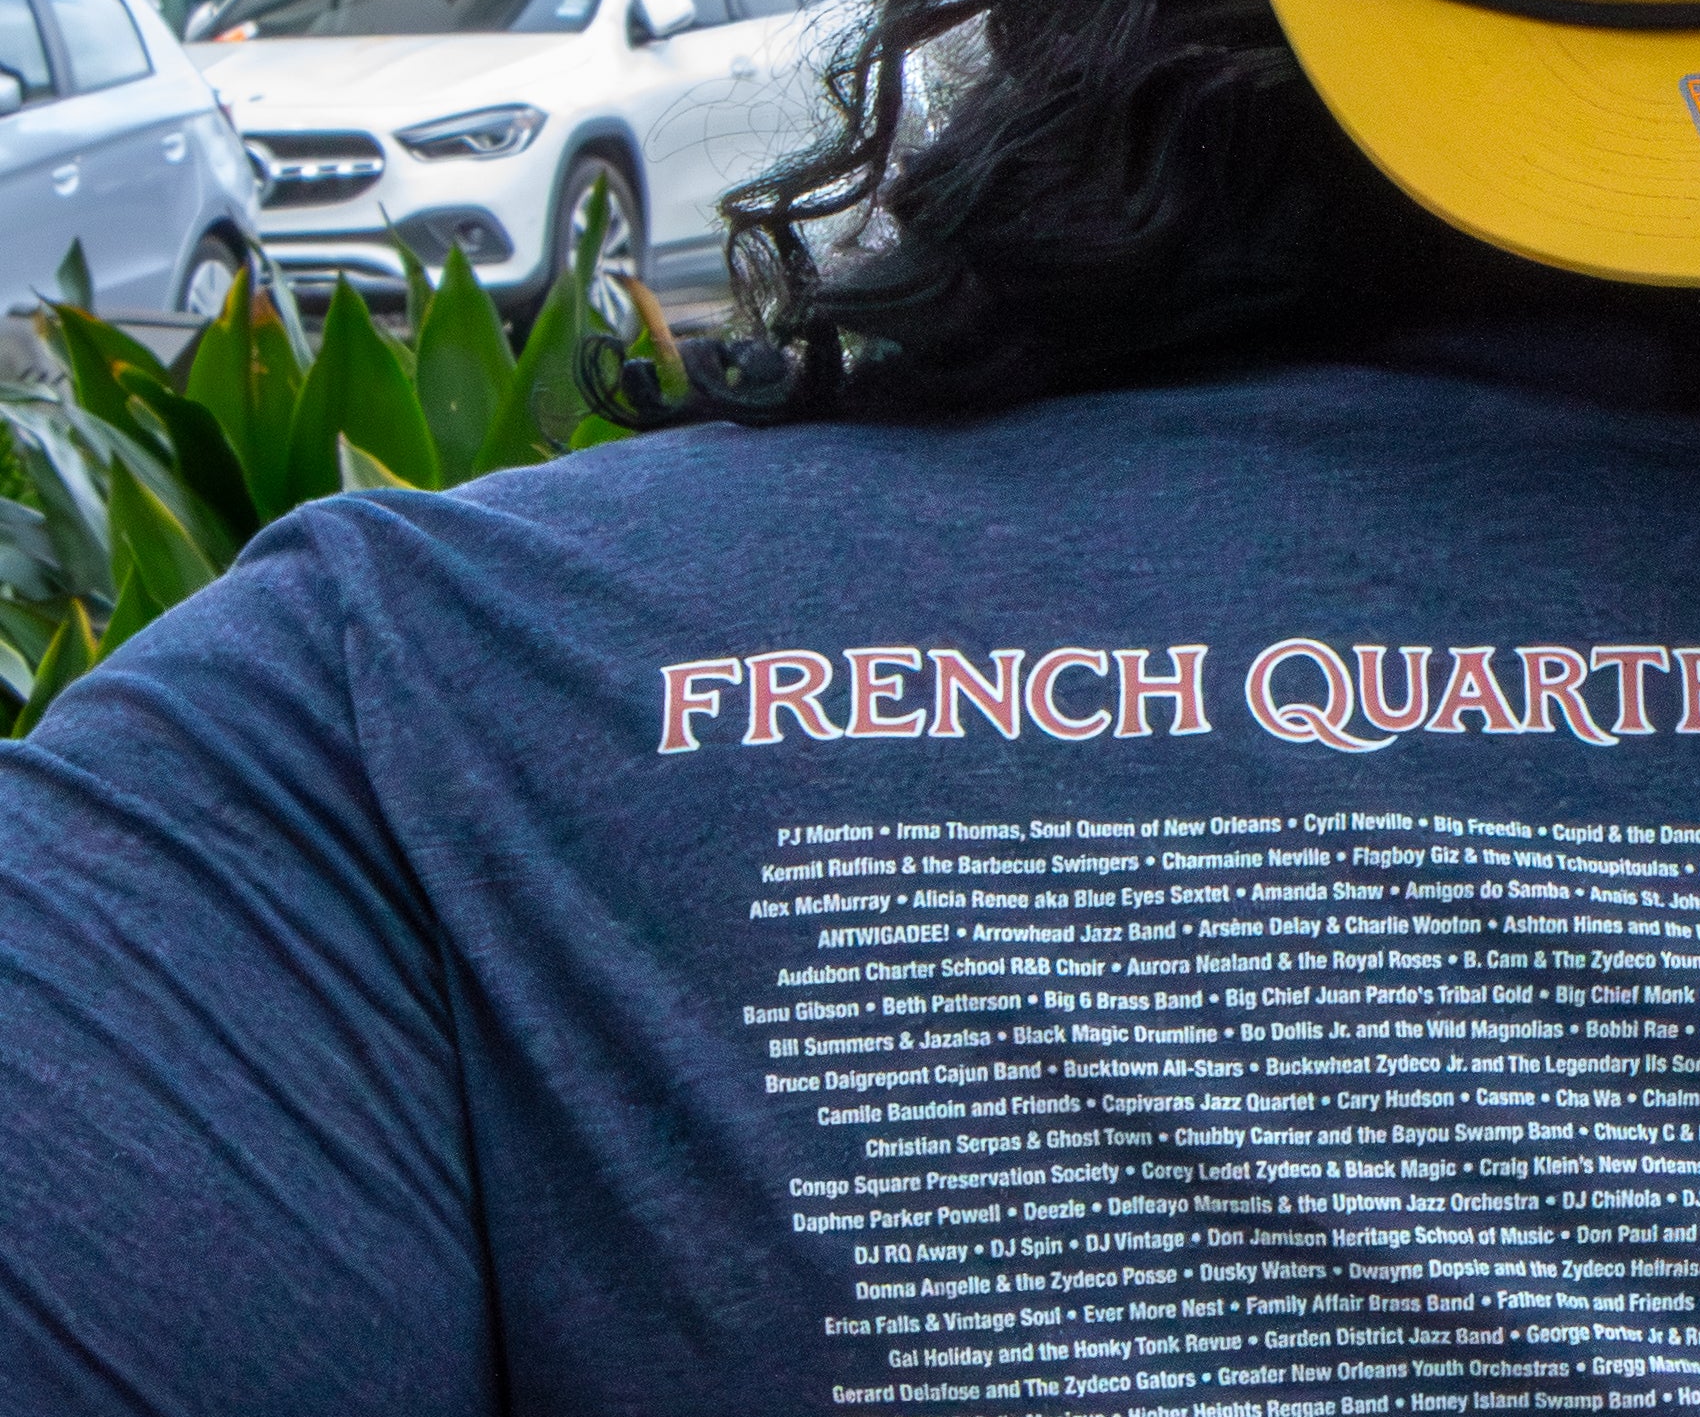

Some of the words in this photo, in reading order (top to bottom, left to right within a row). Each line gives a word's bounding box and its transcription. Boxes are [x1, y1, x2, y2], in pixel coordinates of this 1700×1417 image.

[657, 645, 1212, 754] FRENCH
[946, 822, 1025, 841] Thomas,
[1210, 816, 1281, 835] Orleans
[1352, 812, 1413, 830] Neville
[958, 856, 1046, 874] Barbecue
[1052, 855, 1139, 875] Swingers
[1162, 851, 1263, 870] Charmaine
[1353, 847, 1425, 868] Flagboy
[795, 894, 890, 915] McMurray
[913, 890, 966, 907] Alicia
[1251, 883, 1327, 901] Amanda
[818, 924, 949, 948] ANTWIGADEE!
[973, 924, 1074, 942] Arrowhead
[1345, 916, 1409, 934] Charlie
[1504, 916, 1568, 933] Ashton
[777, 965, 860, 986] Audubon
[866, 961, 936, 980] Charter
[1196, 953, 1272, 973] Nealand
[1591, 950, 1656, 972] Zydeco
[796, 1002, 859, 1020] Gibson
[932, 994, 1021, 1012] Patterson
[805, 1036, 894, 1056] Summers
[1471, 1020, 1563, 1042] Magnolias
[1064, 1060, 1158, 1077] Bucktown
[1163, 1059, 1243, 1077] All-Stars
[1376, 1054, 1441, 1076] Zydeco
[888, 1100, 965, 1121] Baudoin
[1246, 1093, 1314, 1112] Quartet
[1386, 1089, 1454, 1107] Hudson
[866, 1137, 951, 1157] Christian
[1175, 1127, 1245, 1148] Chubby
[1455, 1124, 1524, 1143] Swamp
[927, 1167, 1046, 1189] Preservation
[1051, 1163, 1119, 1184] Society
[793, 1212, 864, 1234] Daphne
[870, 1209, 932, 1228] Parker
[1451, 1193, 1539, 1211] Orchestra
[1332, 1227, 1410, 1248] Heritage
[1501, 1227, 1554, 1245] Music
[921, 1276, 990, 1299] Angelle
[943, 1313, 1015, 1332] Vintage
[1247, 1295, 1307, 1316] Family
[924, 1347, 993, 1367] Holiday
[1337, 1327, 1404, 1345] District
[1065, 1375, 1131, 1397] Zydeco
[1218, 1366, 1286, 1385] Greater
